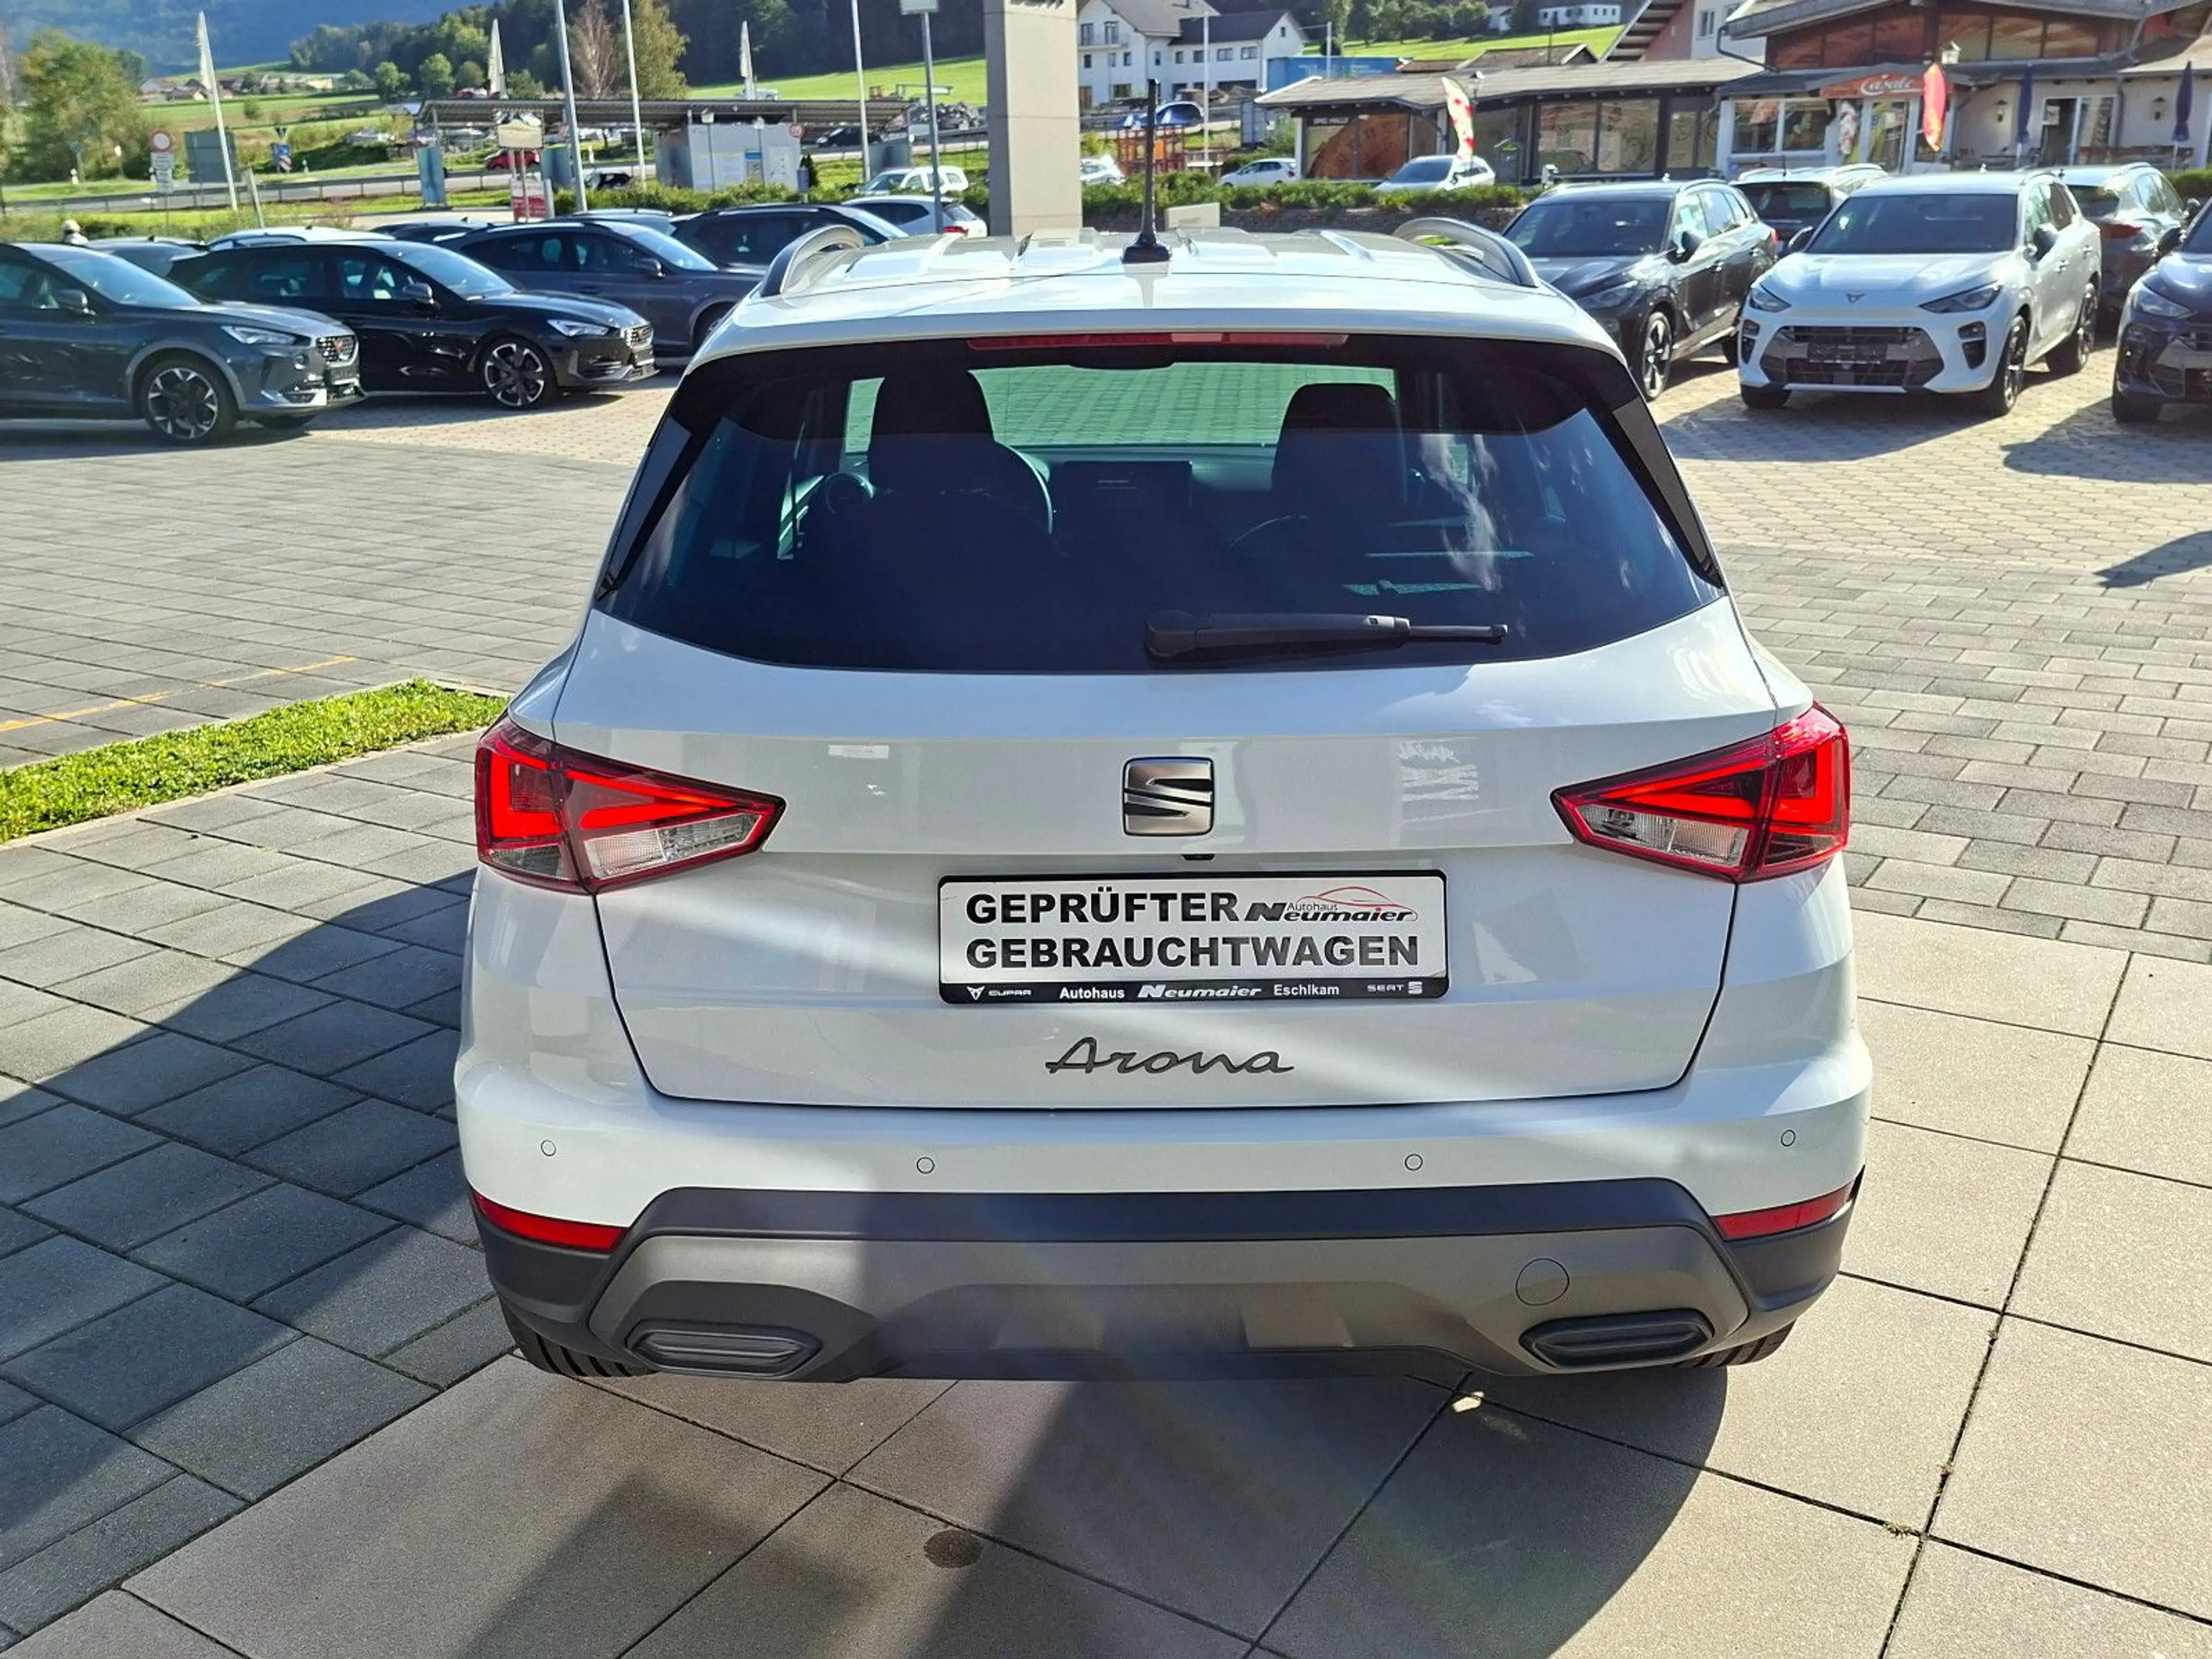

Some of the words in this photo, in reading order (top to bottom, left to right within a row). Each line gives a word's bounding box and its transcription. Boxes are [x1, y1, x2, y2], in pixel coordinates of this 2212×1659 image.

[966, 886, 1241, 924] GEPRÜFTER
[1244, 903, 1414, 922] Neumaier
[1287, 902, 1338, 911] Autohaus
[966, 935, 1418, 969] GEBRAUCHTWAGEN
[1059, 987, 1125, 999] Autohaus
[1137, 984, 1262, 998] Neumaier
[1273, 984, 1339, 997] Eschlkam
[1367, 984, 1404, 992] SEAT
[1045, 1037, 1294, 1074] Arona
